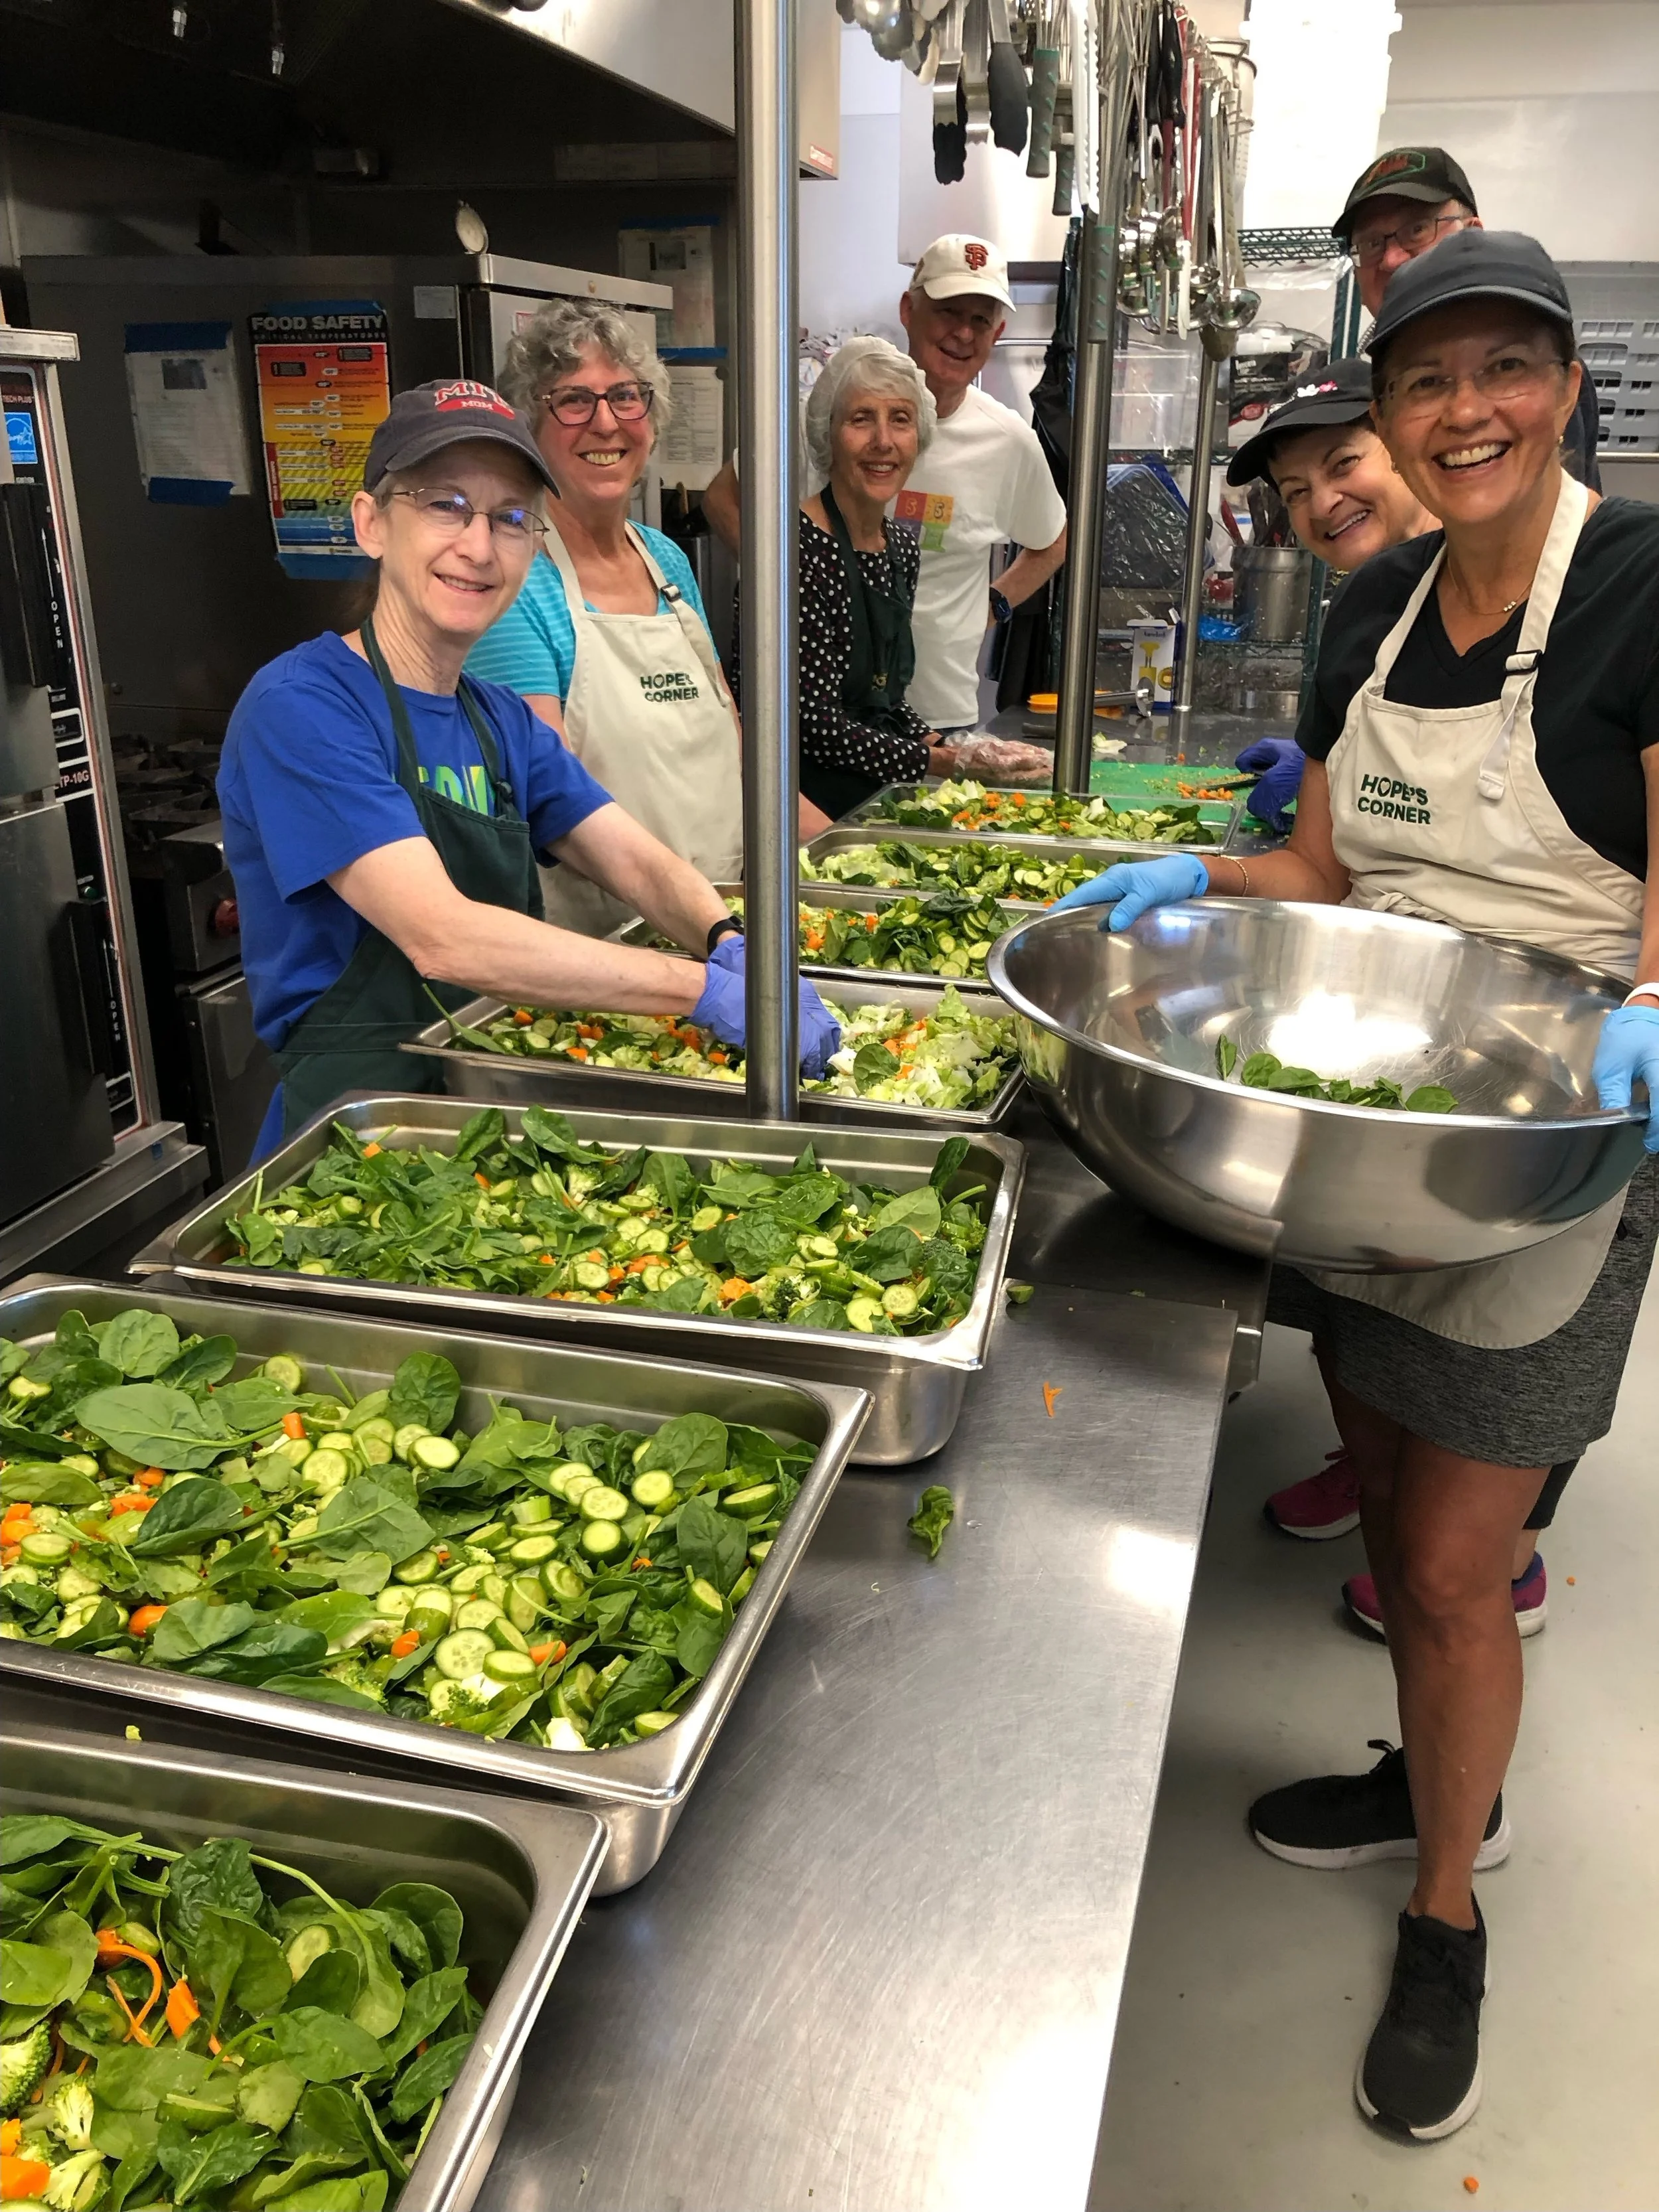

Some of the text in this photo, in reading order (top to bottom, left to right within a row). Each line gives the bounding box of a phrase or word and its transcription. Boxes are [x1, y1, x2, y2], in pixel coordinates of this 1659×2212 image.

[251, 315, 383, 331] FOOD SAFETY
[461, 400, 494, 410] MOM
[51, 601, 64, 648] OPEN
[644, 687, 699, 703] CORNER
[53, 770, 90, 788] TP-10G
[1360, 774, 1429, 806] HOPE'S
[1357, 796, 1431, 825] CORNER
[110, 1000, 121, 1041] OPEN
